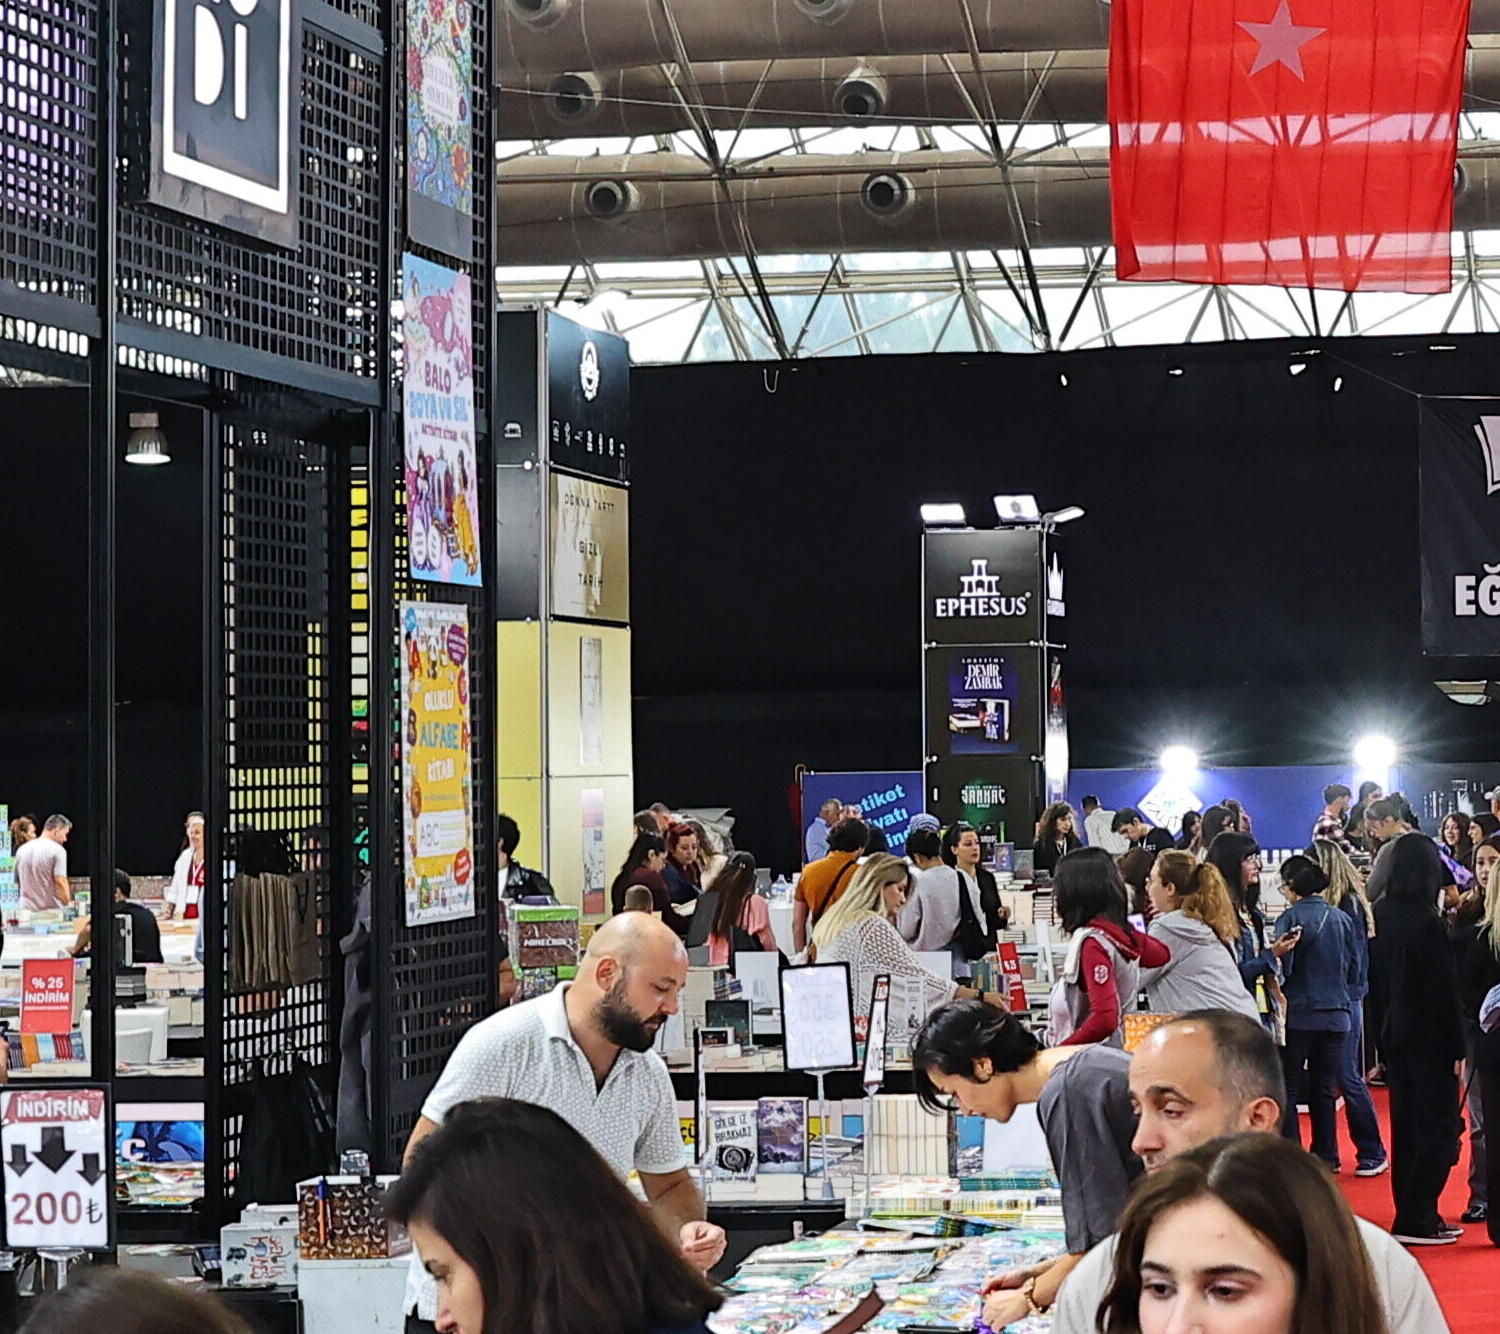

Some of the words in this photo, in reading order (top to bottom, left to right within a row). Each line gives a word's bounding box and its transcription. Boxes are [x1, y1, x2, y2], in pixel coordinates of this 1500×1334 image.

[424, 360, 452, 394] BALO
[935, 596, 1027, 618] EPHESUS
[967, 663, 1000, 678] DEMİR
[963, 676, 1003, 690] ZAMBAK
[421, 720, 460, 749] ALFABE
[420, 823, 440, 847] ABC
[47, 976, 65, 989] 25
[24, 989, 70, 1005] İNDİRİM
[16, 1094, 90, 1121] İNDİRİM
